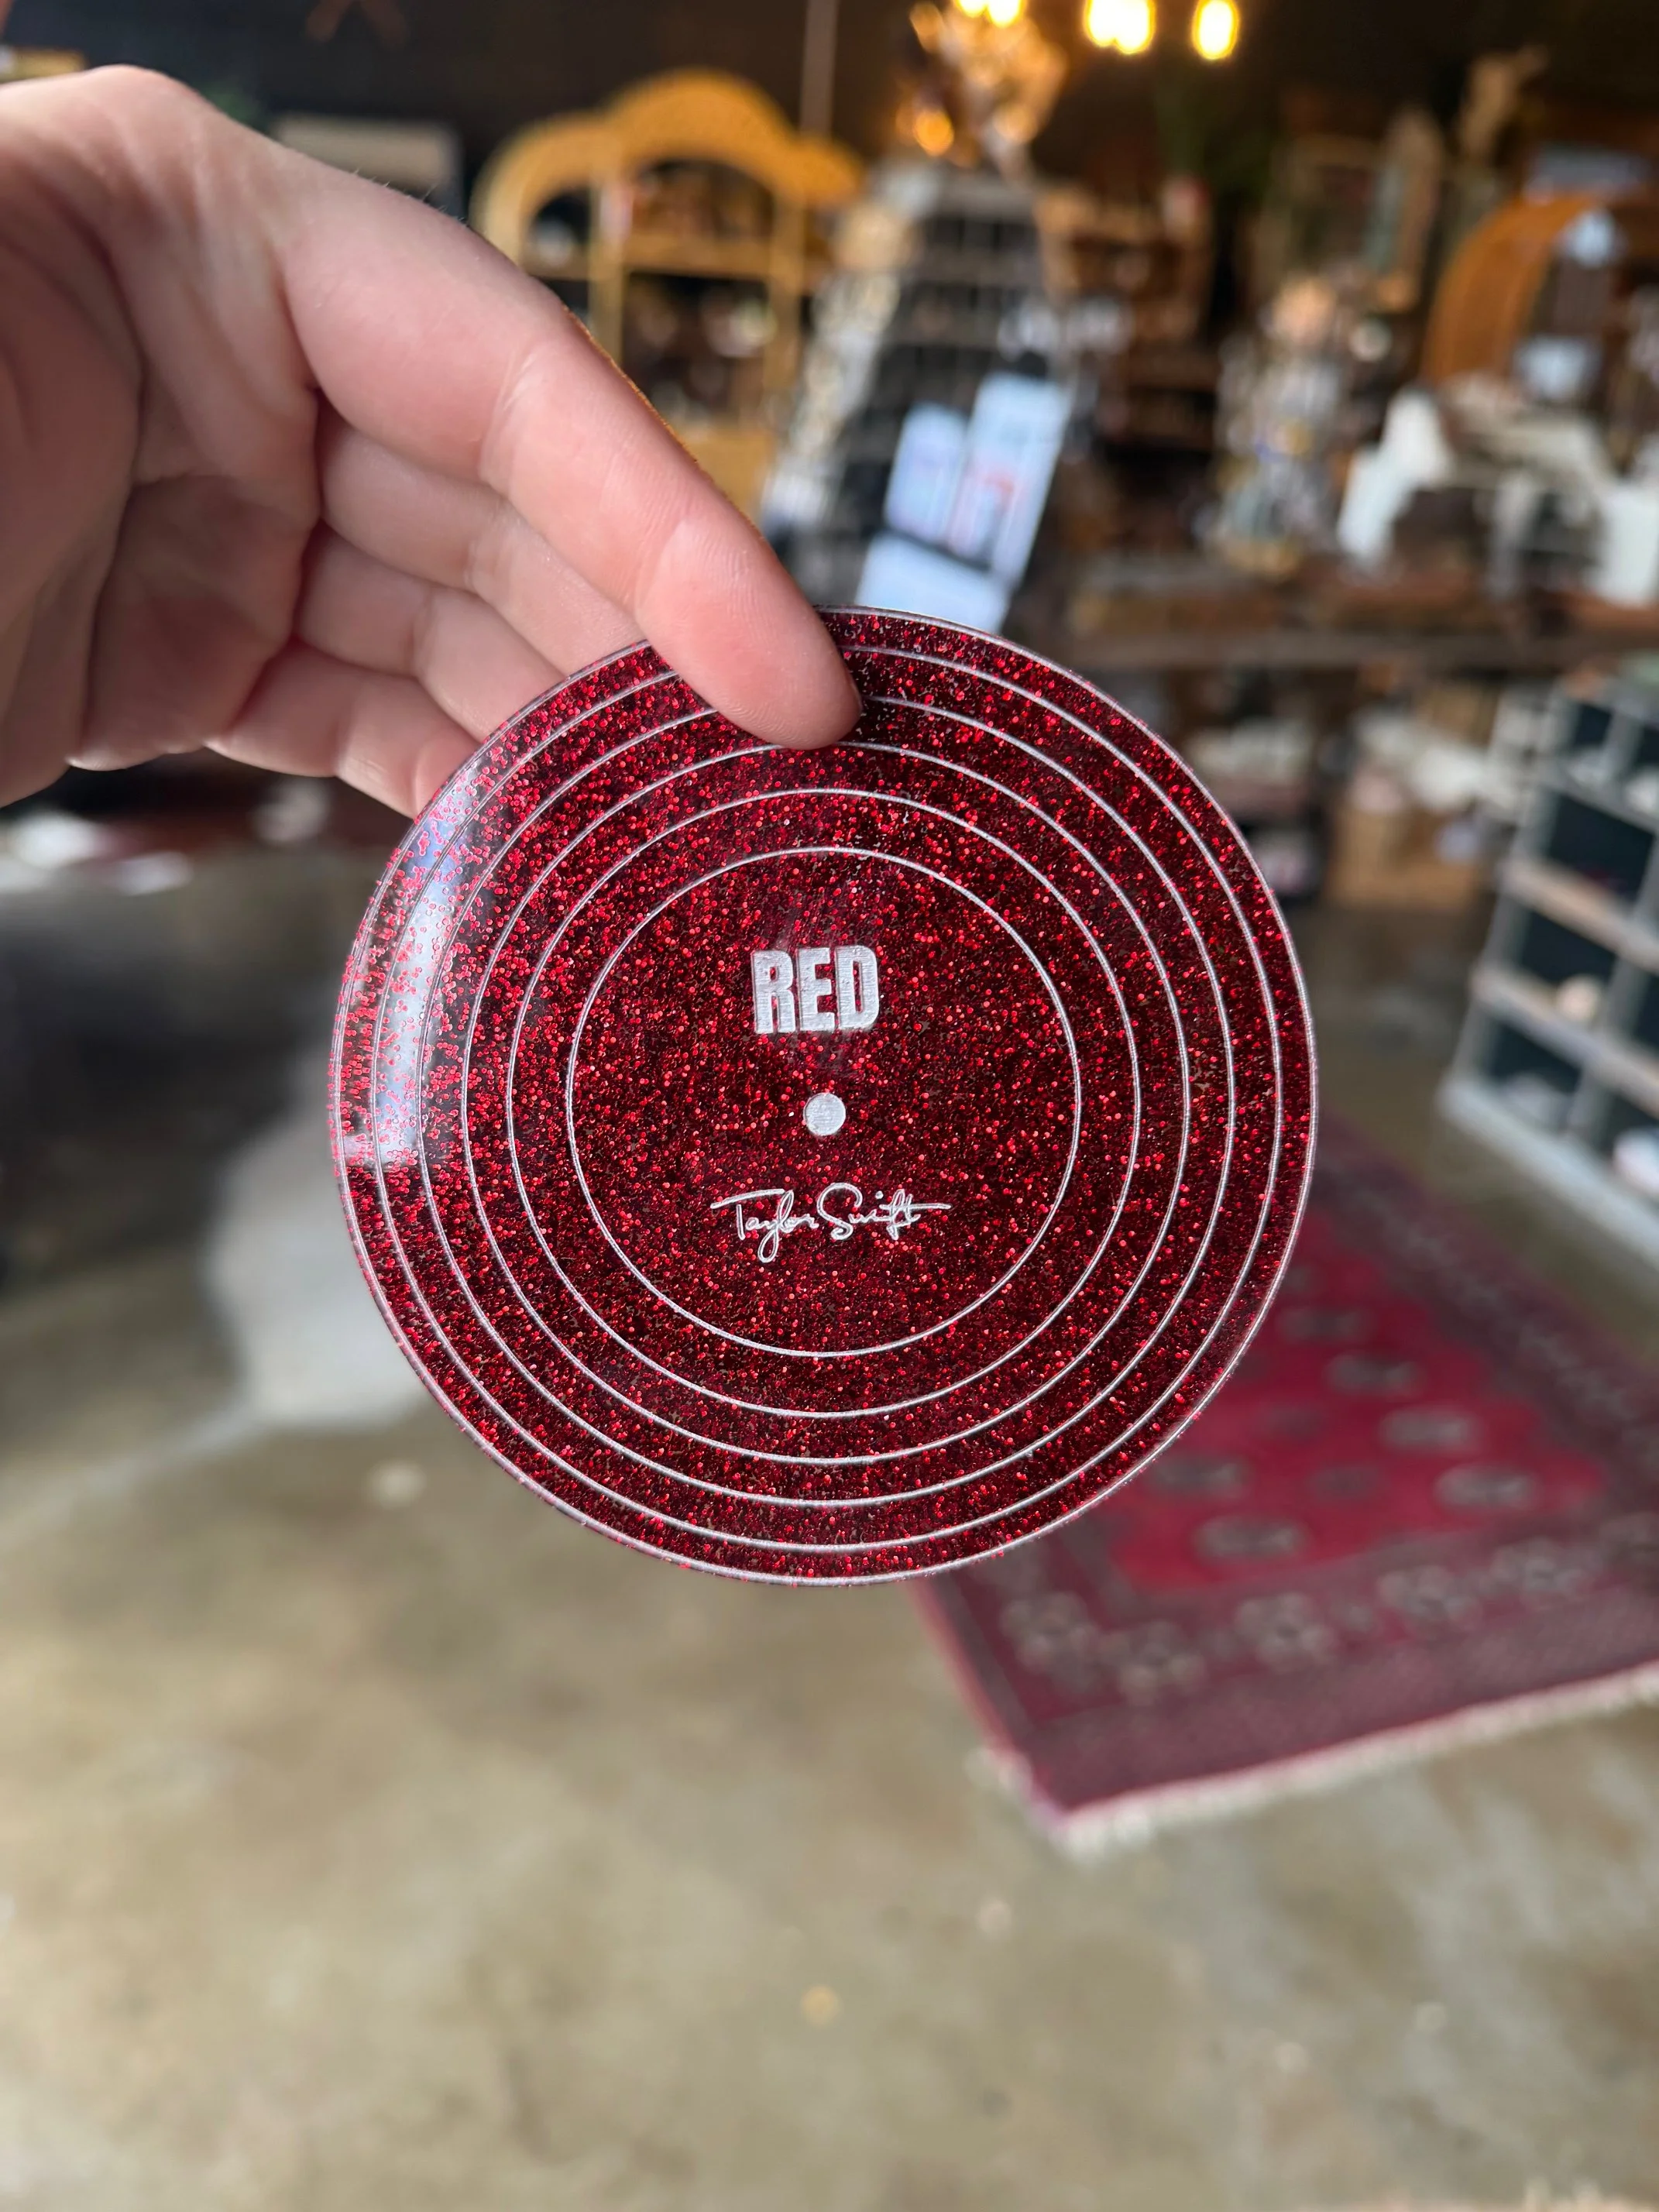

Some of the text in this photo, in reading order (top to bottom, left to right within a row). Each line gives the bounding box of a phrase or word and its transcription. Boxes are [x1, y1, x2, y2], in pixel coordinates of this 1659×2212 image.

[750, 945, 880, 1035] RED
[709, 1182, 952, 1263] Taylor Swift
